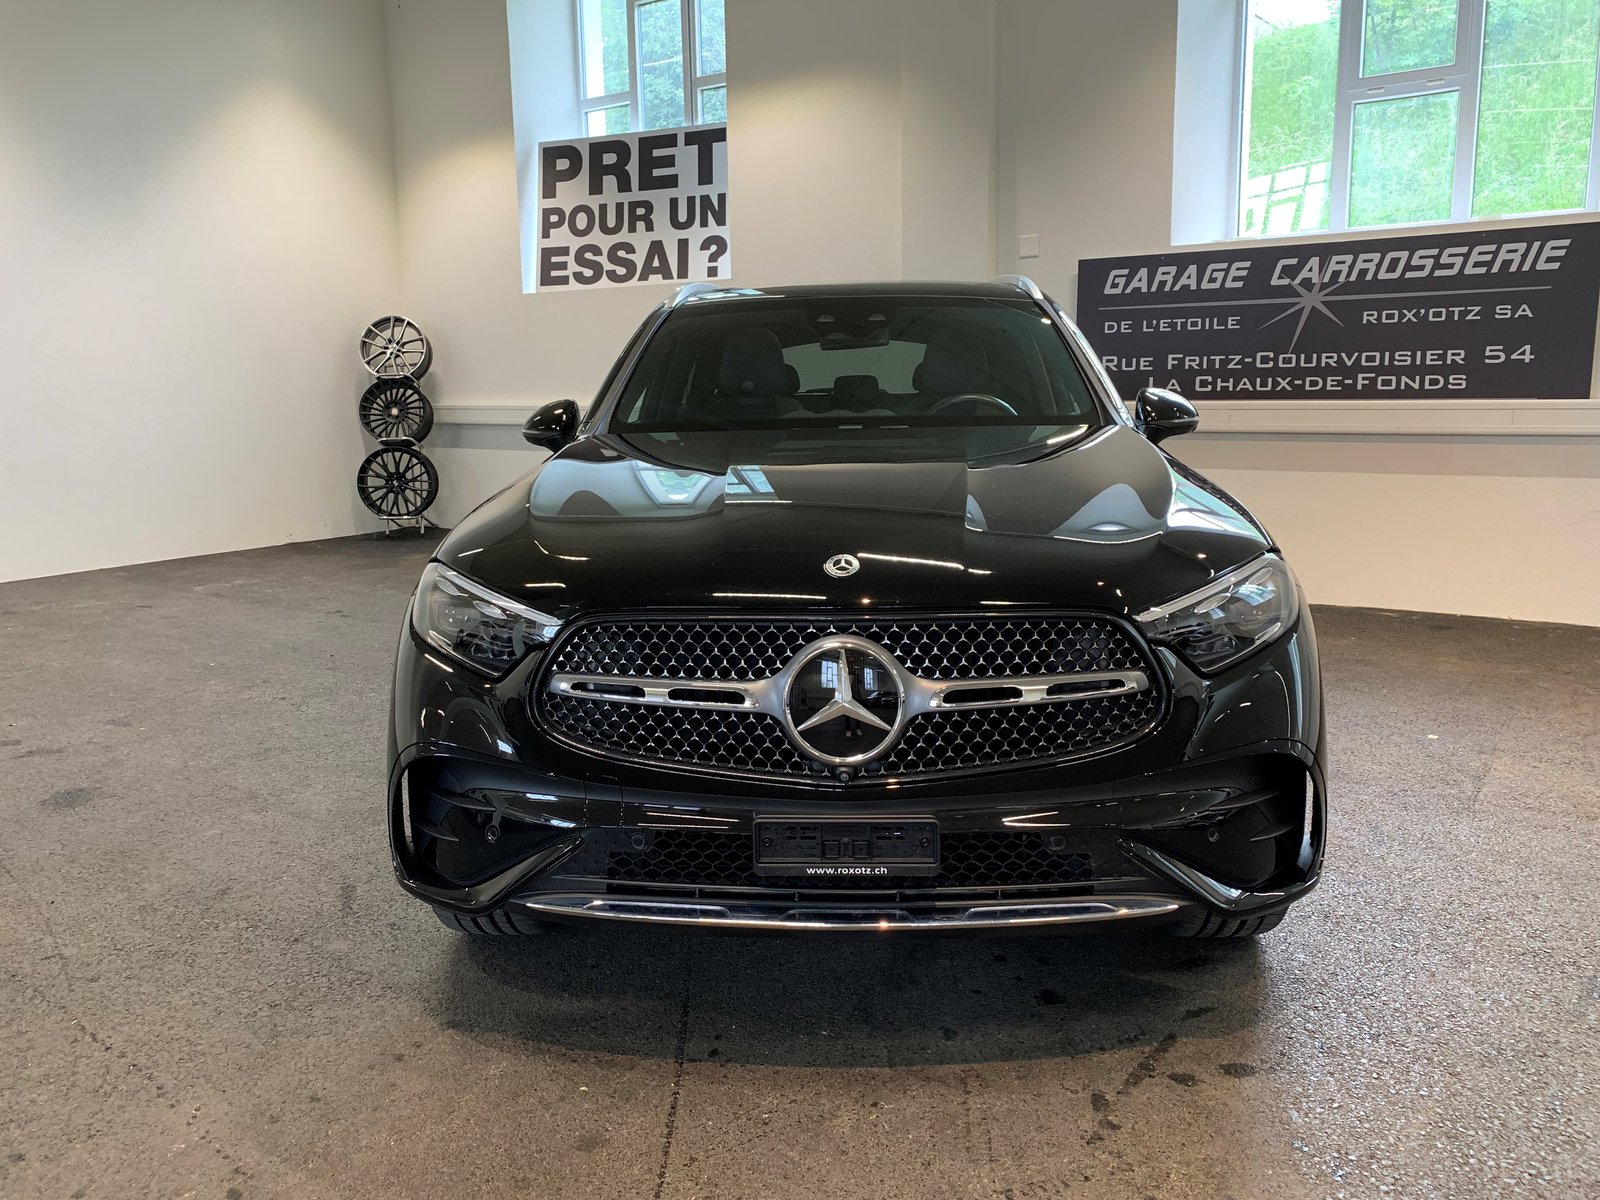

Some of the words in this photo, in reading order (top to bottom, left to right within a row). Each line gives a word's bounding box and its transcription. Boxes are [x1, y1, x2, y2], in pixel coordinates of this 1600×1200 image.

[542, 127, 727, 199] PRET
[541, 200, 655, 239] POUR
[669, 193, 727, 230] UN
[539, 238, 690, 287] ESSAI
[1103, 261, 1251, 295] GARAGE
[1270, 238, 1572, 286] CARROSSERIE
[1104, 321, 1132, 334] DE
[1494, 304, 1534, 319] SA
[1102, 355, 1154, 371] RUE
[1484, 344, 1535, 364] 54
[806, 866, 888, 875] www.roxotz.ch
